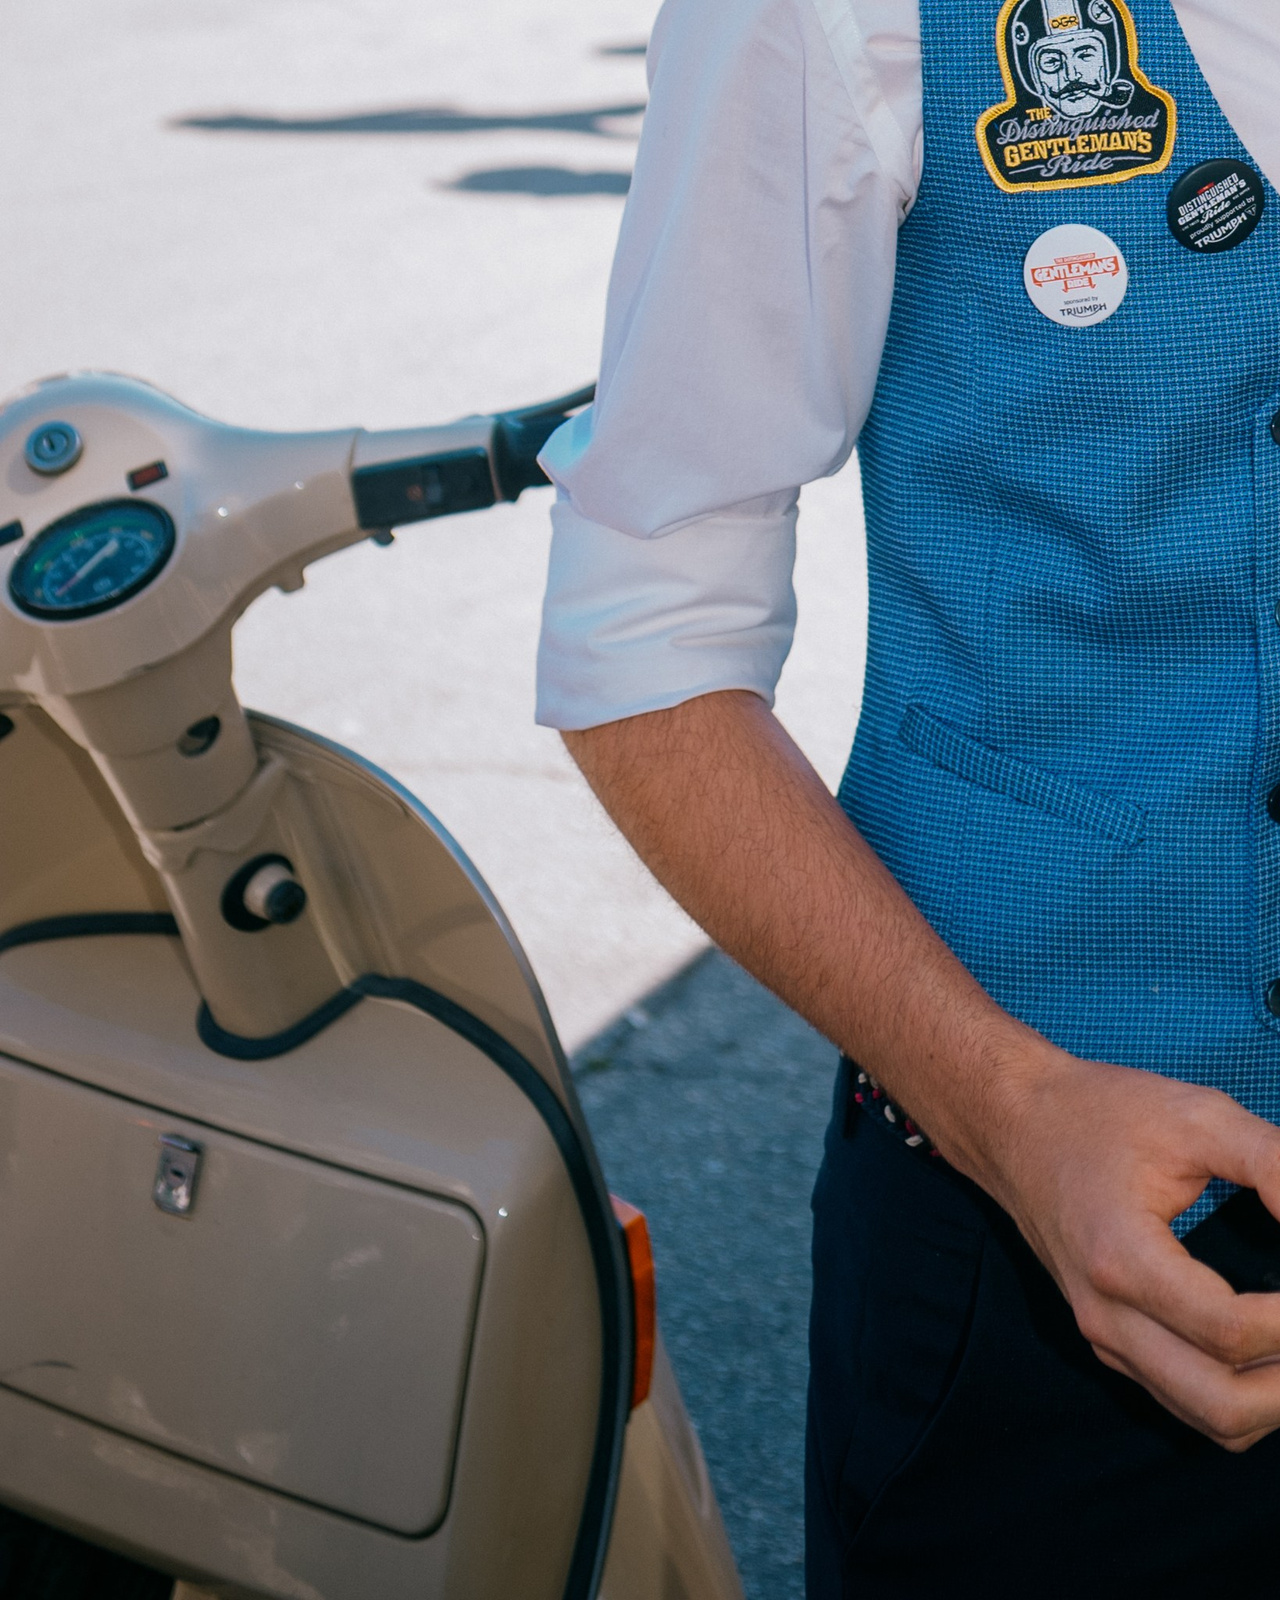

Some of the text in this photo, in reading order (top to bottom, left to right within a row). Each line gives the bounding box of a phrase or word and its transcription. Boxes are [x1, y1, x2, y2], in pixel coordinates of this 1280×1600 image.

[997, 108, 1160, 145] Distinguished
[1025, 108, 1052, 122] THE
[1040, 153, 1115, 177] Ride
[1178, 173, 1239, 216] DISTINGUISHED
[1178, 179, 1246, 225] GENTLEMAN'S
[1200, 201, 1231, 224] Ride
[1189, 222, 1214, 239] proudly
[1214, 201, 1246, 224] supported
[1246, 195, 1255, 204] by
[1194, 212, 1247, 248] TRIUMPH
[1060, 303, 1107, 318] TRIUMPH
